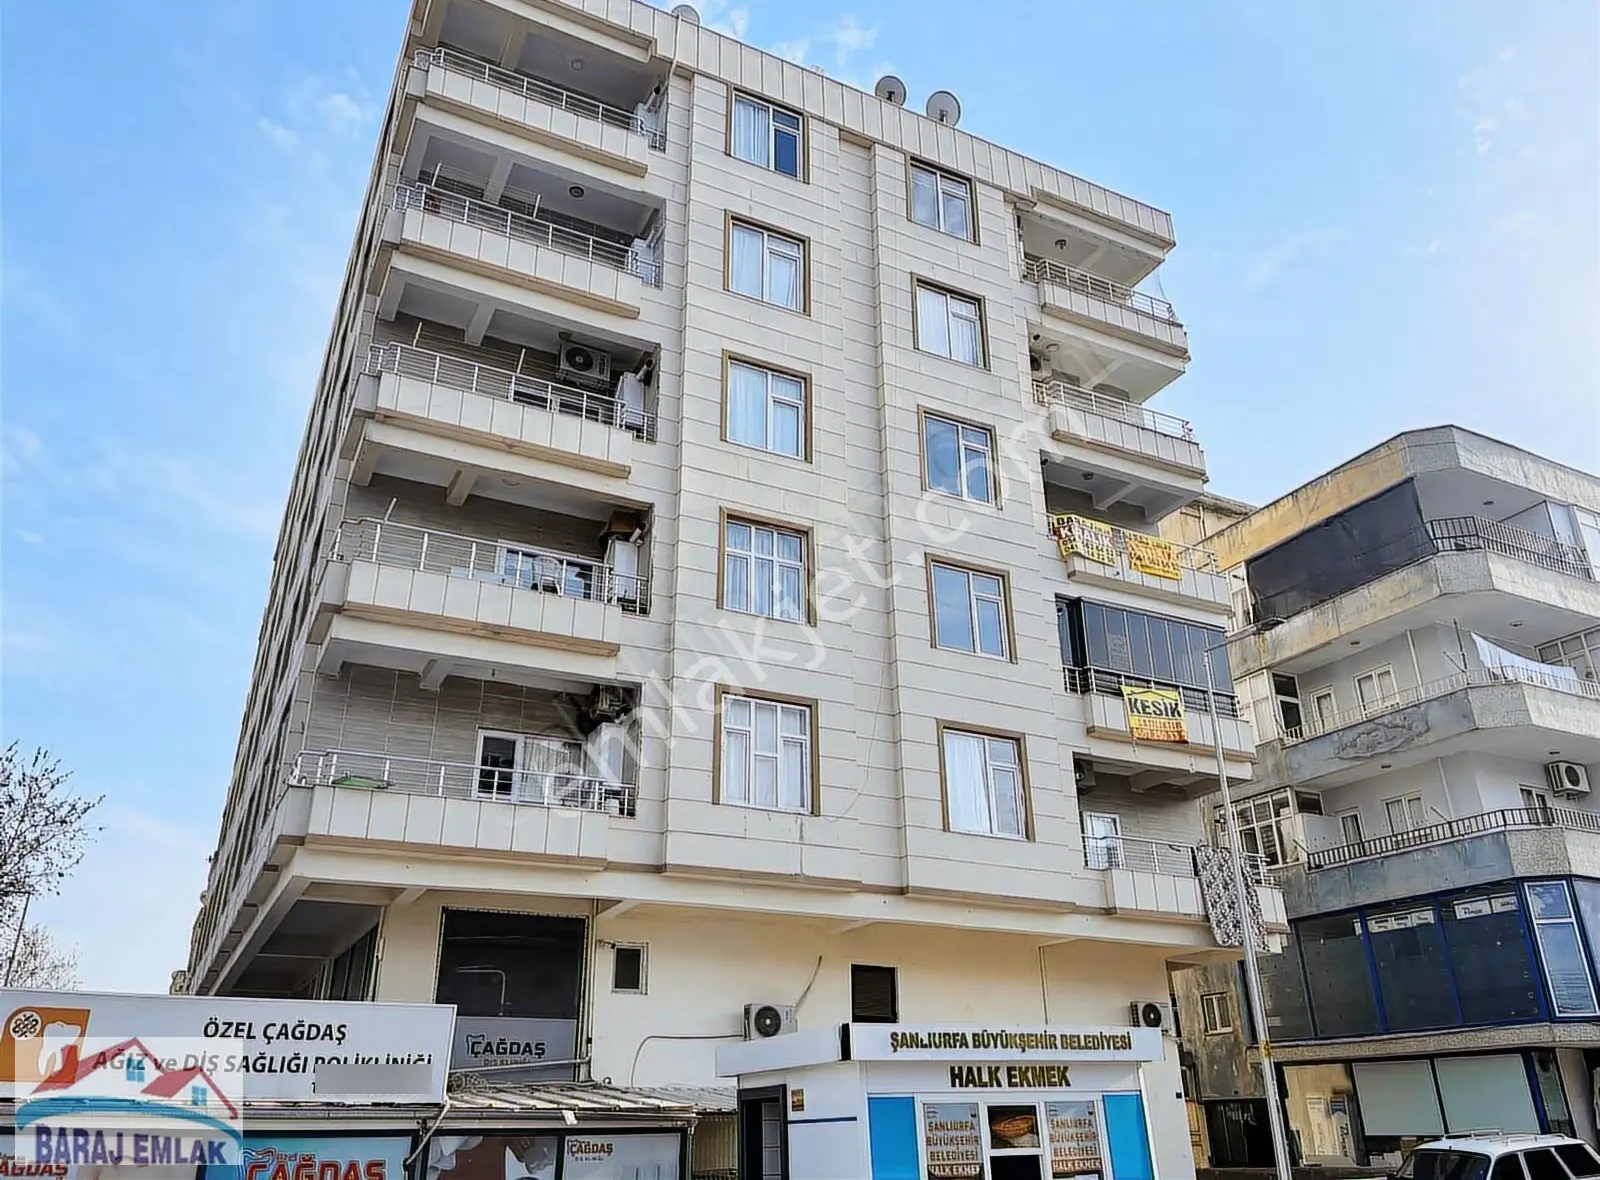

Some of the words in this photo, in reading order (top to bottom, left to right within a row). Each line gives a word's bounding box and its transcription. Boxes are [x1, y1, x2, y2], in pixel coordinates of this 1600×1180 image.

[1128, 697, 1182, 718] KESİK
[203, 1017, 257, 1040] ÖZEL
[263, 1020, 347, 1045] ÇAĞDAŞ
[890, 1030, 968, 1053] ŞANLIURFA
[972, 1029, 1058, 1053] BÜYÜKŞEHİR
[1060, 1031, 1132, 1050] BELEDİYESİ
[471, 1036, 546, 1059] ÇAĞDAŞ
[92, 1048, 149, 1070] AĞIZ
[154, 1057, 177, 1071] ve
[183, 1051, 219, 1076] DİŞ
[224, 1052, 308, 1074] SAĞLIĞI
[950, 1065, 1002, 1088] HALK
[1008, 1065, 1071, 1088] EKMEK
